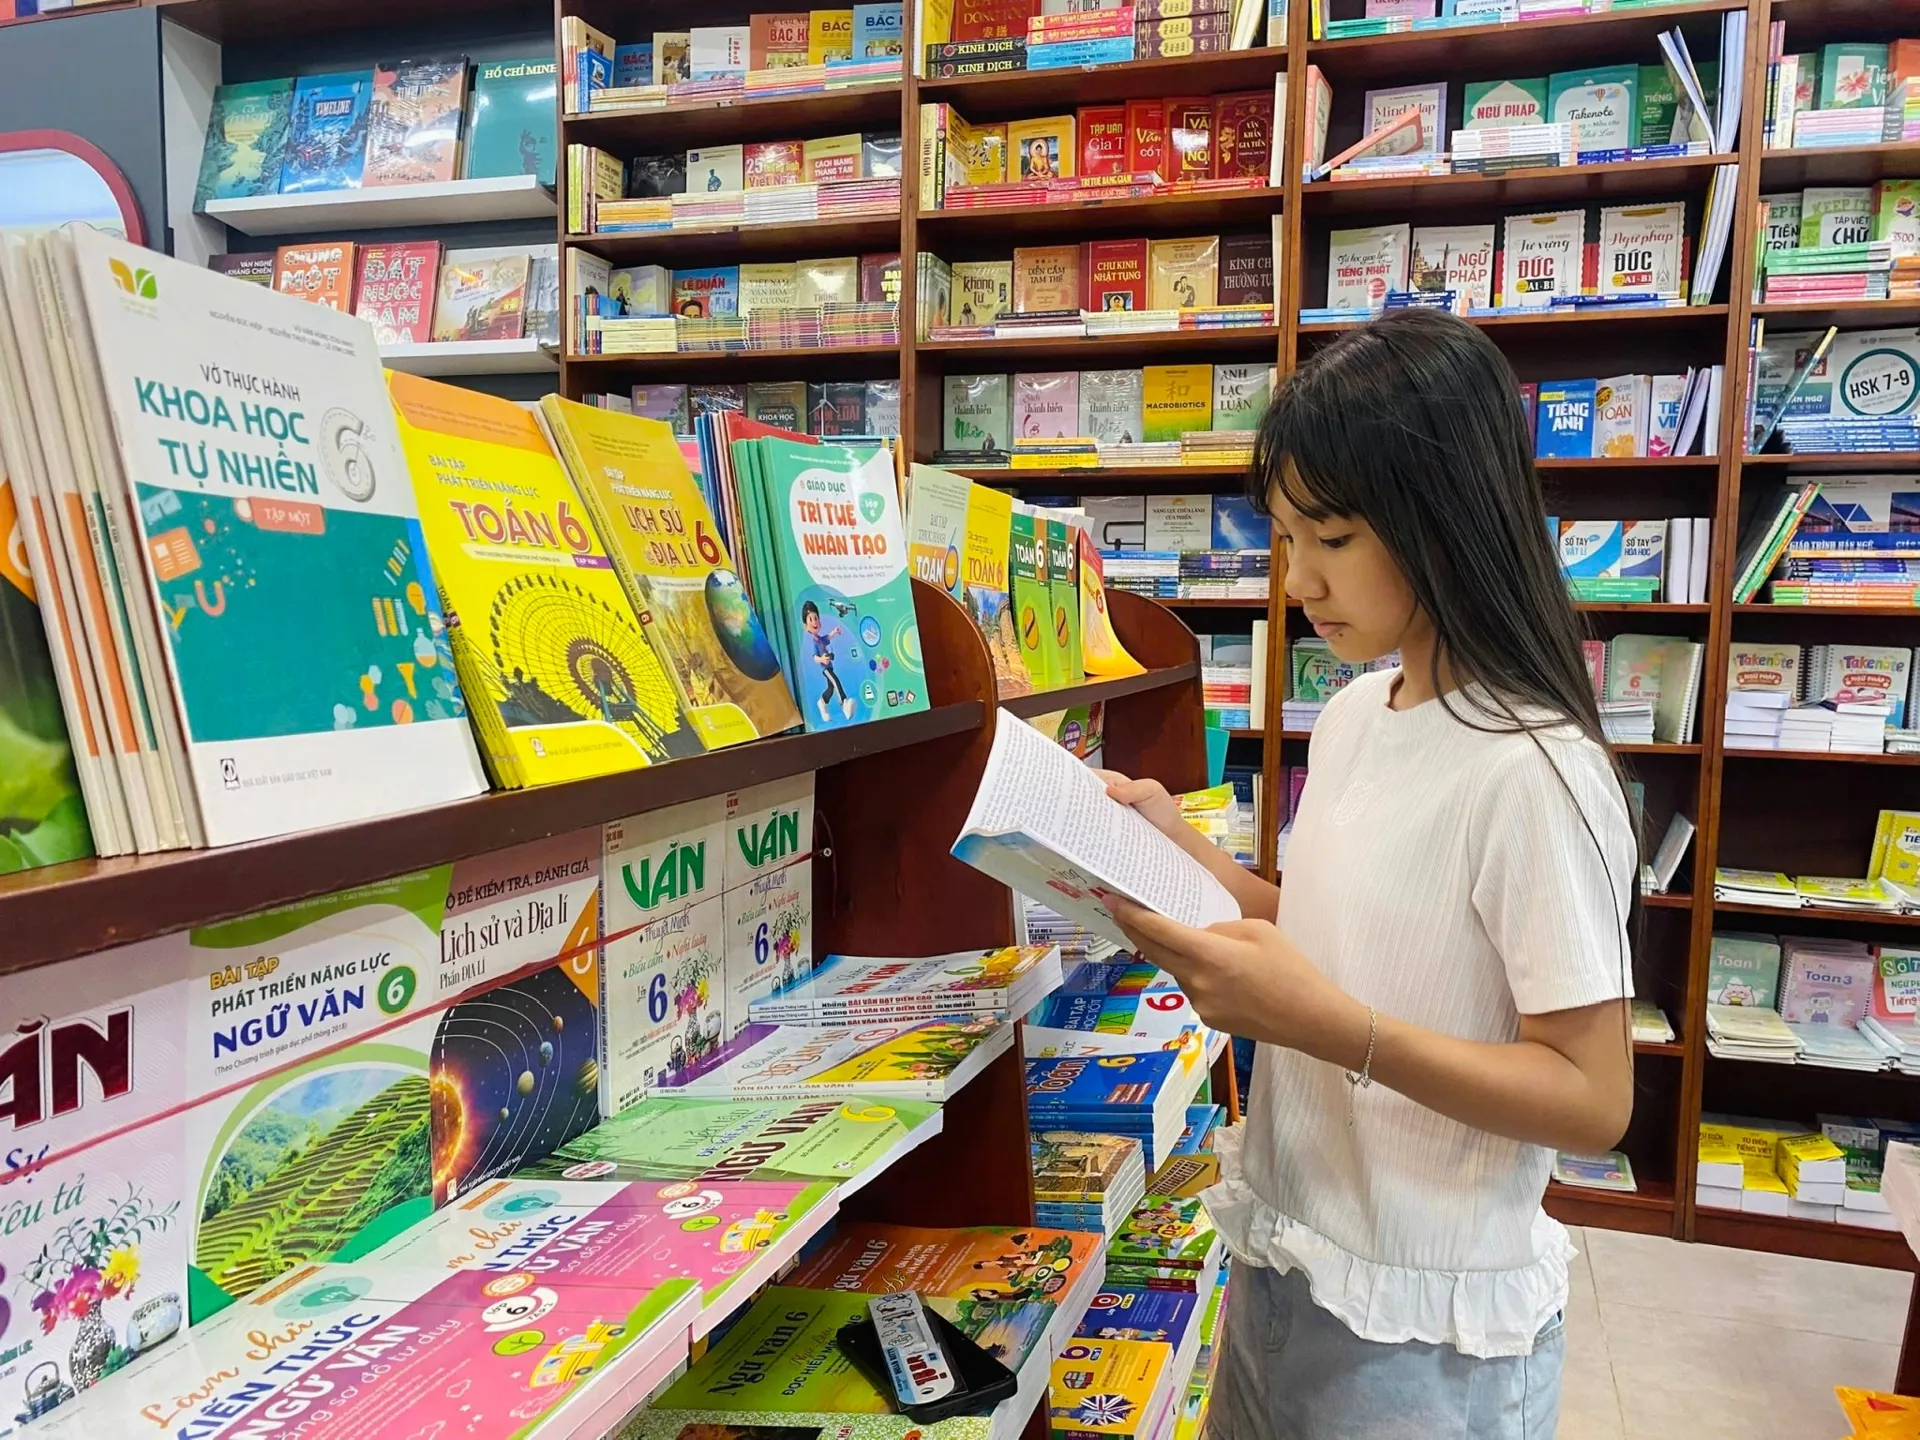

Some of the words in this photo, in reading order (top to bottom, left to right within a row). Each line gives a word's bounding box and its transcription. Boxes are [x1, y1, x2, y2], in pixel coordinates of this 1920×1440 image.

[958, 43, 985, 54] KINH
[987, 41, 1013, 53] DỊCH
[485, 65, 502, 79] HỒ
[504, 65, 524, 77] CHÍ
[958, 63, 985, 74] KINH
[987, 61, 1013, 72] DỊCH
[316, 100, 351, 116] TIMELINE
[1568, 107, 1614, 121] Takenote
[1088, 137, 1112, 151] Gia
[746, 157, 763, 175] 25
[364, 256, 426, 282] ĐẤT
[1115, 260, 1137, 270] KINH
[1458, 250, 1490, 266] NGỮ
[1518, 255, 1554, 279] ĐỨC
[1614, 248, 1652, 272] ĐỨC
[681, 277, 696, 291] LÊ
[1449, 266, 1487, 283] PHÁP
[200, 363, 221, 385] VỞ
[224, 369, 259, 393] THỰC
[262, 377, 301, 402] HÀNH
[1220, 384, 1244, 398] LẠC
[1850, 378, 1880, 400] HSK
[1882, 369, 1911, 391] 7-9
[134, 376, 237, 433] KHOA
[241, 400, 310, 449] HỌC
[758, 413, 778, 421] KHOA
[779, 413, 794, 422] HỌC
[1146, 401, 1206, 410] MACROBIOTICS
[1220, 400, 1252, 413] LUẬN
[1547, 400, 1589, 419] TIẾNG
[1552, 416, 1584, 432] ANH
[158, 438, 208, 489] TỰ
[217, 449, 320, 495] NHIÊN
[318, 406, 376, 503] 6
[428, 455, 446, 469] BÀI
[446, 458, 467, 473] TẬP
[436, 472, 462, 487] PHÁT
[463, 475, 491, 491] TRIỂN
[490, 479, 520, 495] NĂNG
[521, 484, 541, 499] LỰC
[806, 478, 826, 492] GIÁO
[828, 482, 846, 496] DỤC
[263, 507, 286, 523] TẬP
[288, 510, 311, 528] MỘT
[449, 499, 559, 549] TOÁN
[557, 501, 591, 554] 6
[622, 503, 659, 538] LỊCH
[659, 501, 685, 535] SỬ
[797, 498, 822, 525] TRÍ
[824, 500, 857, 529] TUỆ
[649, 541, 682, 575] ĐỊA
[680, 536, 699, 566] LÍ
[695, 520, 720, 565] 6
[803, 531, 849, 556] NHÂN
[850, 534, 887, 559] TẠO
[1015, 539, 1035, 565] TOÁN
[1036, 540, 1044, 567] 6
[1576, 538, 1588, 546] TAY
[916, 551, 944, 584] TOÁN
[968, 550, 996, 582] TOÁN
[1052, 544, 1067, 569] TOÁN
[1066, 544, 1074, 571] 6
[1736, 652, 1794, 670] Takenote
[1843, 655, 1905, 673] Takenote
[737, 808, 799, 868] VĂN
[457, 887, 474, 907] ĐỀ
[475, 878, 505, 901] KIỂM
[506, 876, 533, 893] TRA,
[535, 865, 569, 884] ĐÁNH
[571, 857, 590, 875] GIÁ
[621, 839, 706, 910] VĂN
[440, 922, 475, 966] Lịch
[480, 914, 501, 951] sử
[504, 909, 523, 941] và
[528, 901, 554, 935] Địa
[558, 892, 569, 925] lí
[755, 921, 769, 965] 6
[210, 965, 243, 991] BÀI
[244, 956, 280, 982] TẬP
[211, 985, 256, 1017] PHÁT
[259, 973, 306, 1001] TRIỂN
[310, 962, 357, 986] NĂNG
[361, 952, 391, 974] LỰC
[440, 967, 461, 990] Phần
[461, 962, 477, 981] ĐỊA
[1843, 975, 1853, 984] 3
[386, 974, 405, 1006] 6
[648, 972, 668, 1024] 6
[213, 1003, 291, 1059] NGỮ
[297, 985, 365, 1028] VĂN
[1064, 1011, 1079, 1030] BÀI
[1074, 996, 1087, 1014] TẬP
[1097, 1056, 1137, 1068] 6
[839, 1105, 897, 1123] 6
[702, 1141, 787, 1182] NGỮ
[757, 1101, 843, 1138] VĂN
[4, 1144, 49, 1186] Sự
[53, 1172, 86, 1213] tả
[682, 1200, 700, 1209] 6
[496, 1214, 578, 1259] THỨC
[549, 1219, 615, 1251] VĂN
[868, 1239, 889, 1250] 6
[506, 1305, 529, 1317] 6
[329, 1386, 359, 1408] sơ
[361, 1361, 391, 1384] đồ
[387, 1345, 418, 1363] tư
[418, 1318, 462, 1346] duy
[706, 1361, 766, 1397] Ngữ
[753, 1324, 794, 1358] văn
[785, 1310, 809, 1322] 6
[1059, 1345, 1091, 1360] 6
[140, 1366, 240, 1430] Làm
[246, 1318, 314, 1363] chủ
[177, 1382, 277, 1440] KIẾN
[262, 1312, 382, 1376] THỨC
[228, 1374, 335, 1440] NGỮ
[328, 1324, 422, 1370] VĂN
[781, 1376, 807, 1397] ĐỌC
[801, 1352, 828, 1380] HIỂU
